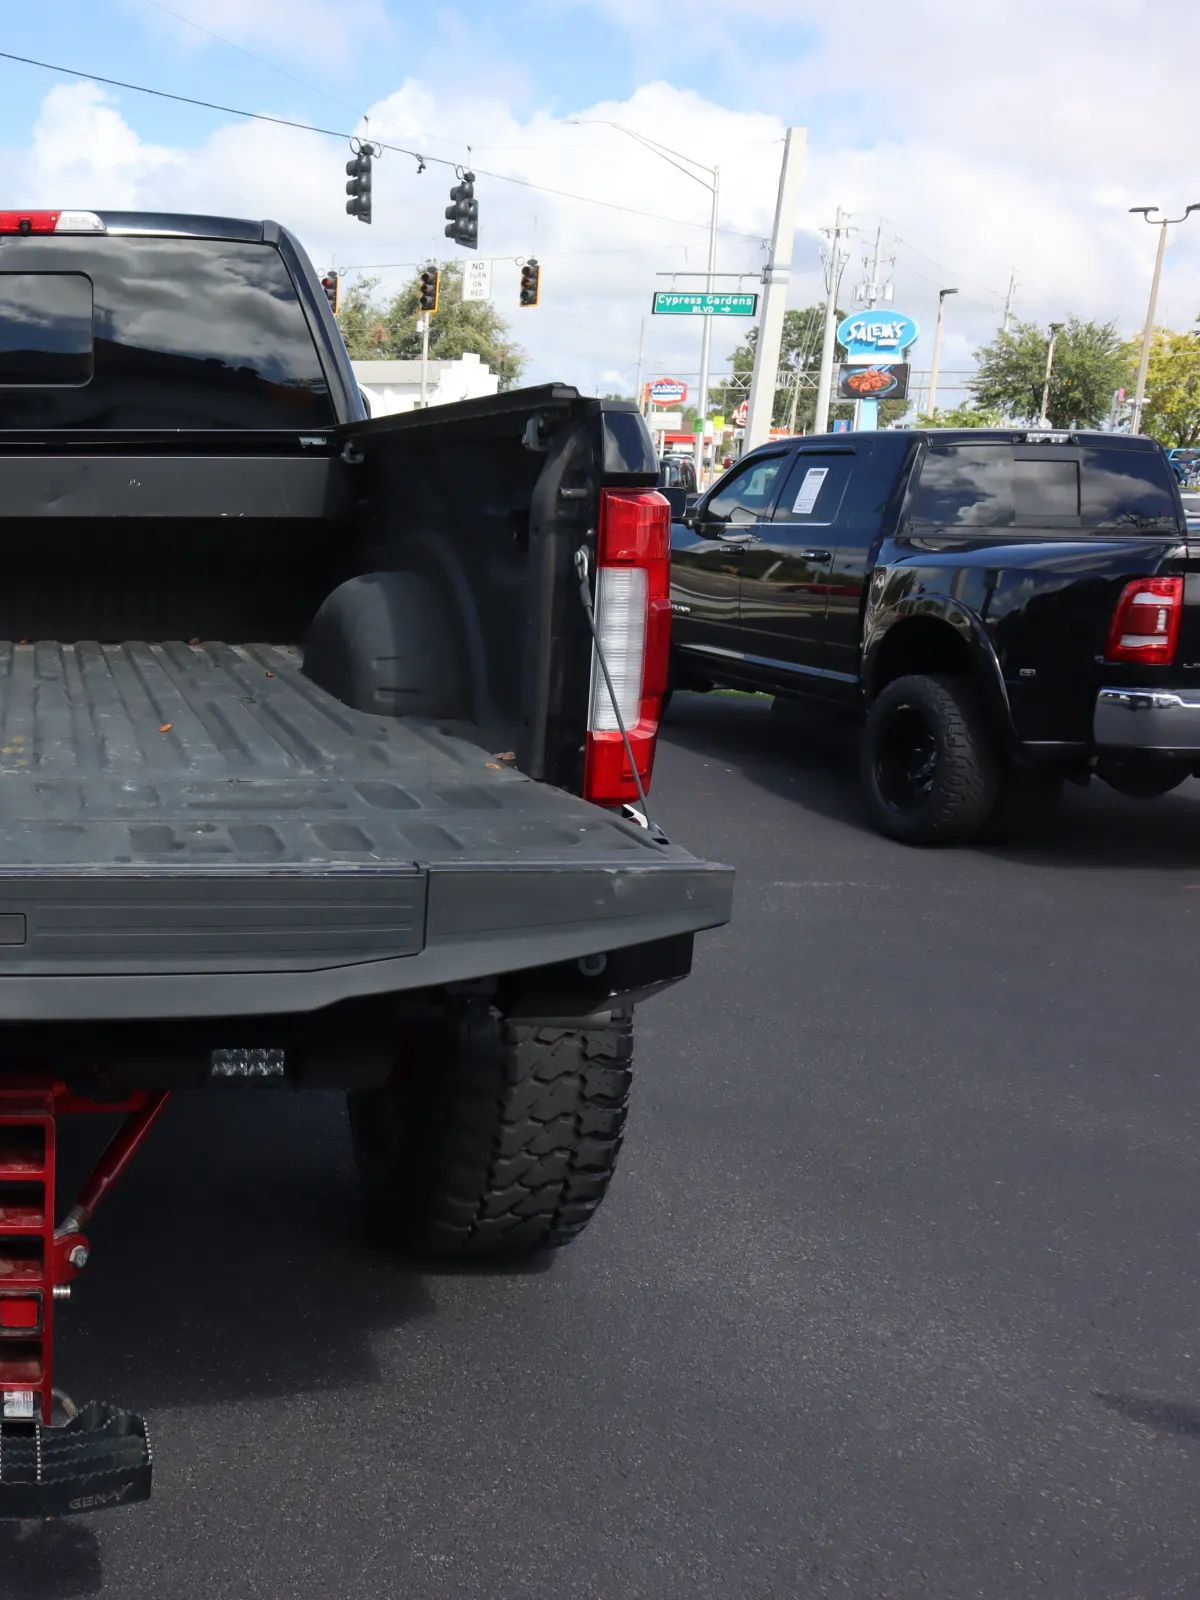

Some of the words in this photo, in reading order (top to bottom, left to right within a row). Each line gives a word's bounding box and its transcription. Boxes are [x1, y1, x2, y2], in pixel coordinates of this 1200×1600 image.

[472, 262, 485, 270] NO
[658, 294, 702, 306] Cypress
[706, 295, 752, 305] Gardens
